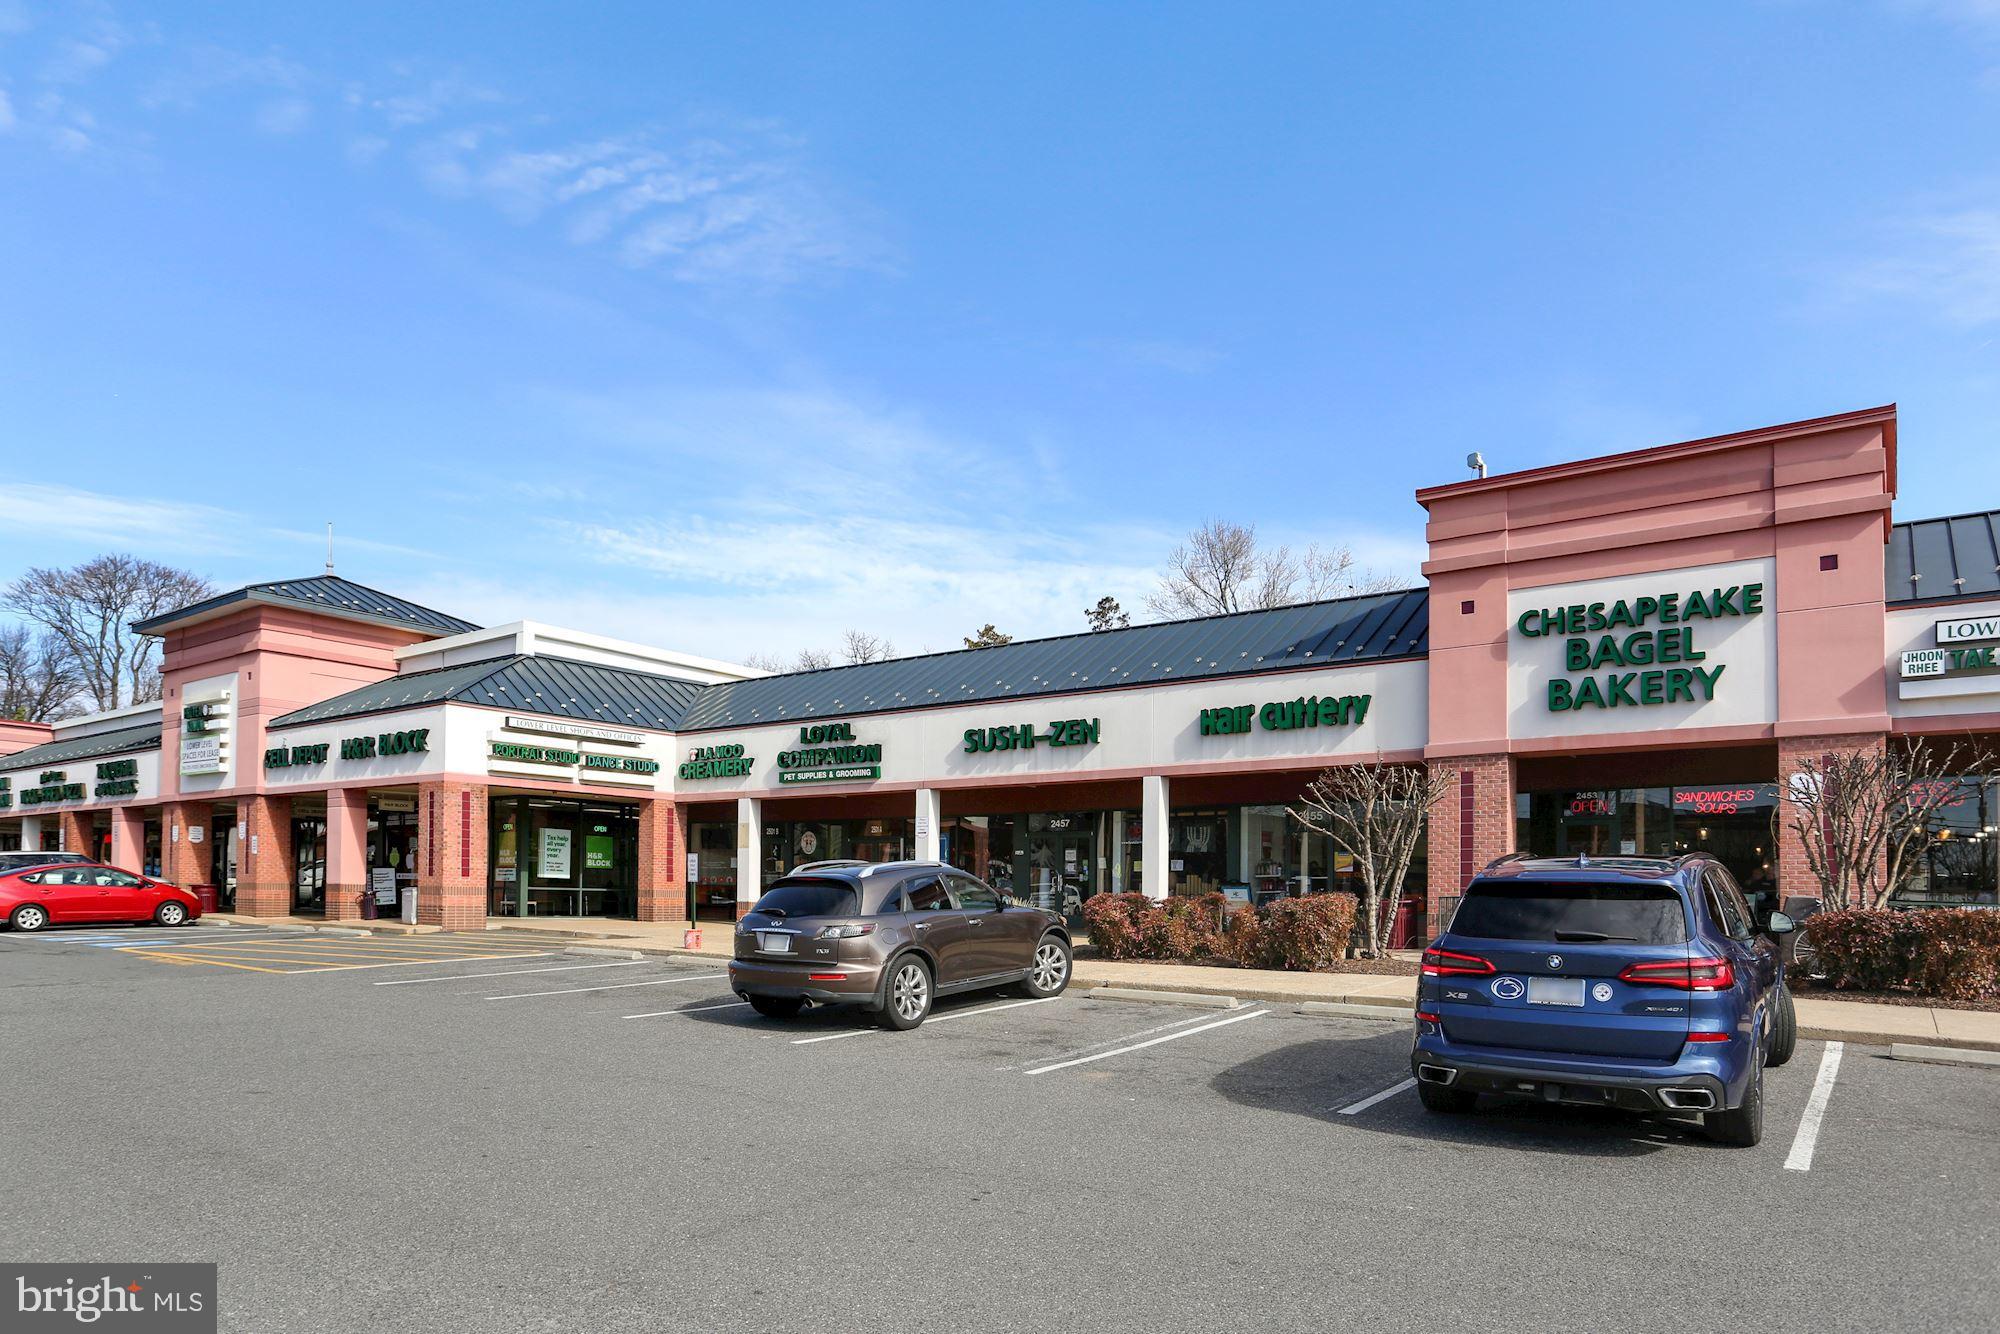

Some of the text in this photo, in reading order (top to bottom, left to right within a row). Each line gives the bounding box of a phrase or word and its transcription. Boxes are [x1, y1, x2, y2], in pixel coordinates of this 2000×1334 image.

[1517, 582, 1764, 637] CHESAPEAKE
[1947, 620, 2000, 639] LOW
[1565, 626, 1706, 672] BAGEL
[1903, 650, 1943, 664] JHOON
[1950, 645, 1997, 671] TAE
[1908, 662, 1938, 674] RHEE
[1547, 664, 1727, 712] BAKERY
[1200, 703, 1256, 736] Hair
[516, 719, 643, 743] LOWER LEVEL SHOPS AND OFFICES
[800, 722, 856, 744] LOYAL
[963, 717, 1100, 753] SUSHI-ZEN
[341, 728, 430, 761] H&R BLOCK
[494, 743, 580, 765] PORTRAIT STUDIO
[715, 743, 744, 758] MOO
[265, 743, 330, 770] CELL DEPOT
[587, 754, 660, 773] DANCE STUDIO
[777, 744, 882, 768] COMPANION
[678, 757, 754, 780] CREAMERY
[783, 768, 872, 781] PET SUPPLIES & GROOMING
[1675, 789, 1755, 803] SANDWICHES
[1571, 799, 1609, 816] OPEN
[1694, 802, 1737, 814] SOUPS
[1050, 819, 1071, 828] 2457
[587, 859, 611, 867] BLOCK
[1445, 990, 1468, 1000] X5
